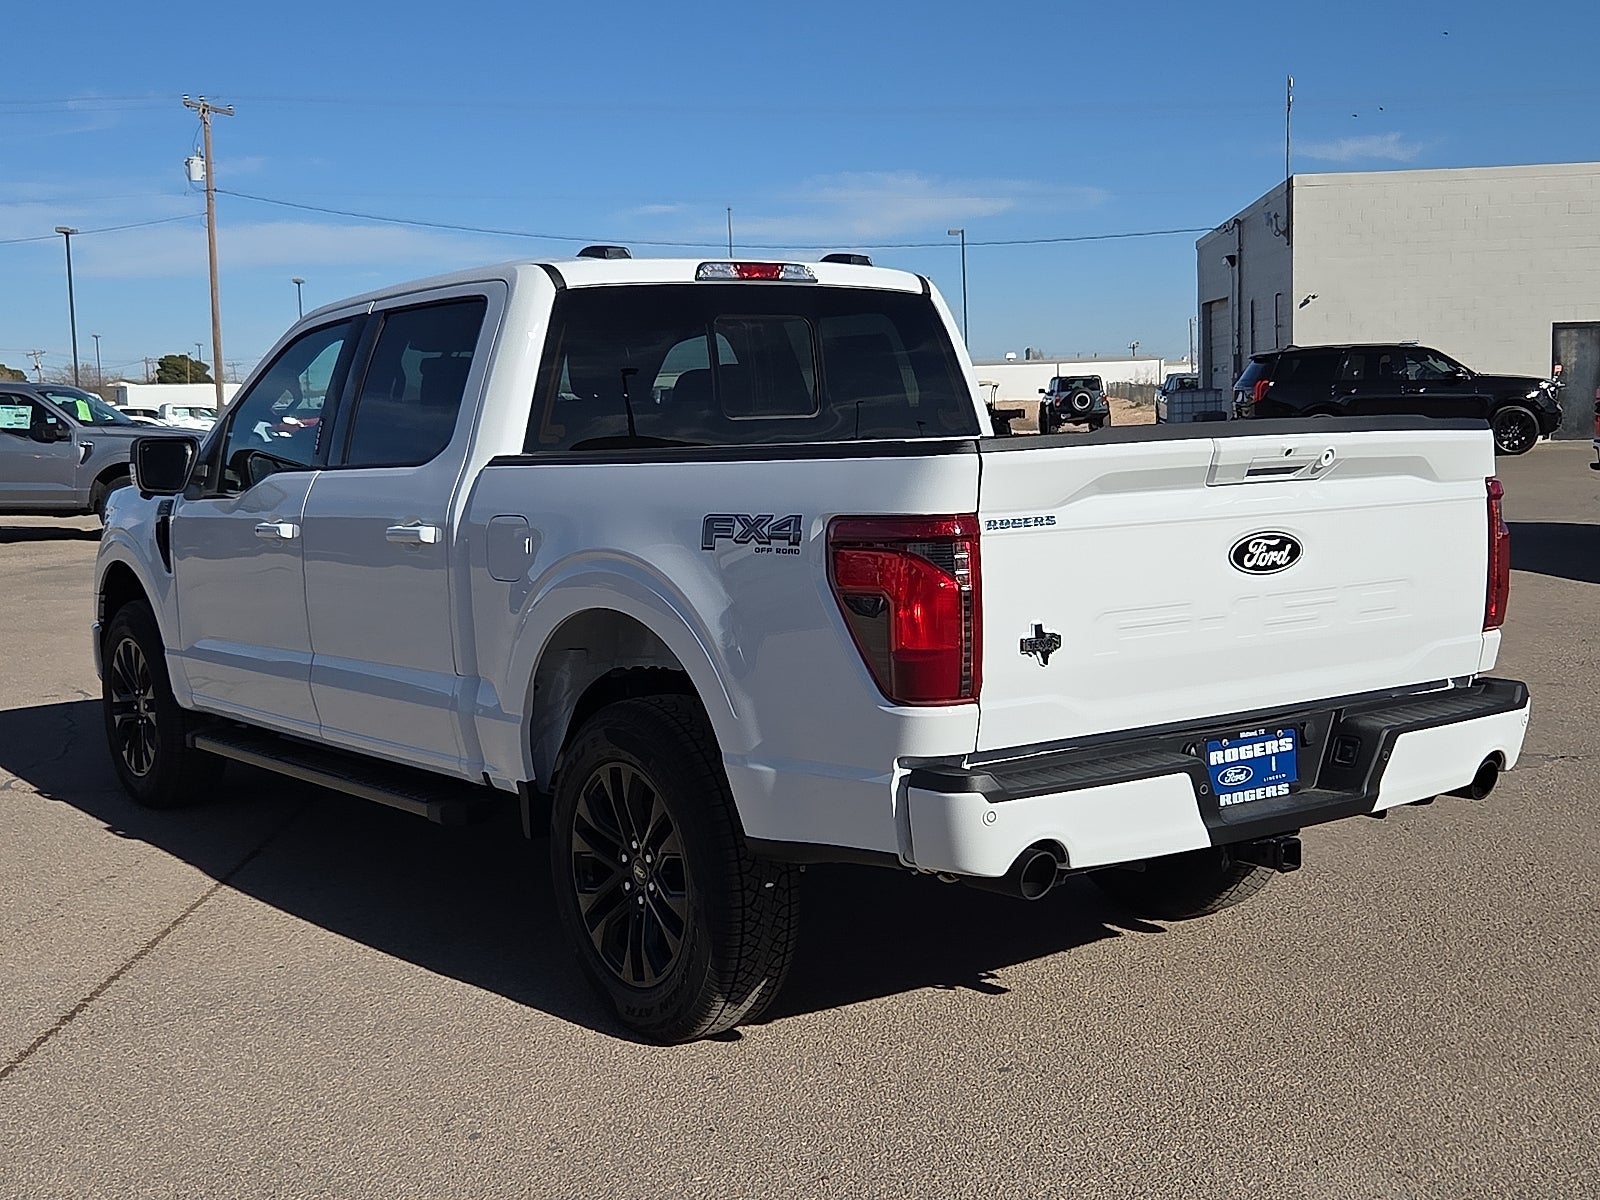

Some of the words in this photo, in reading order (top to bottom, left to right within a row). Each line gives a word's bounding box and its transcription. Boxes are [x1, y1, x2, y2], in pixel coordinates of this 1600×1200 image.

[701, 513, 802, 550] FX4
[984, 515, 1056, 531] ROGERS
[1243, 538, 1292, 568] Ford
[1209, 737, 1293, 766] ROGERS
[1224, 768, 1247, 783] Ford
[1219, 783, 1290, 807] ROGERS
